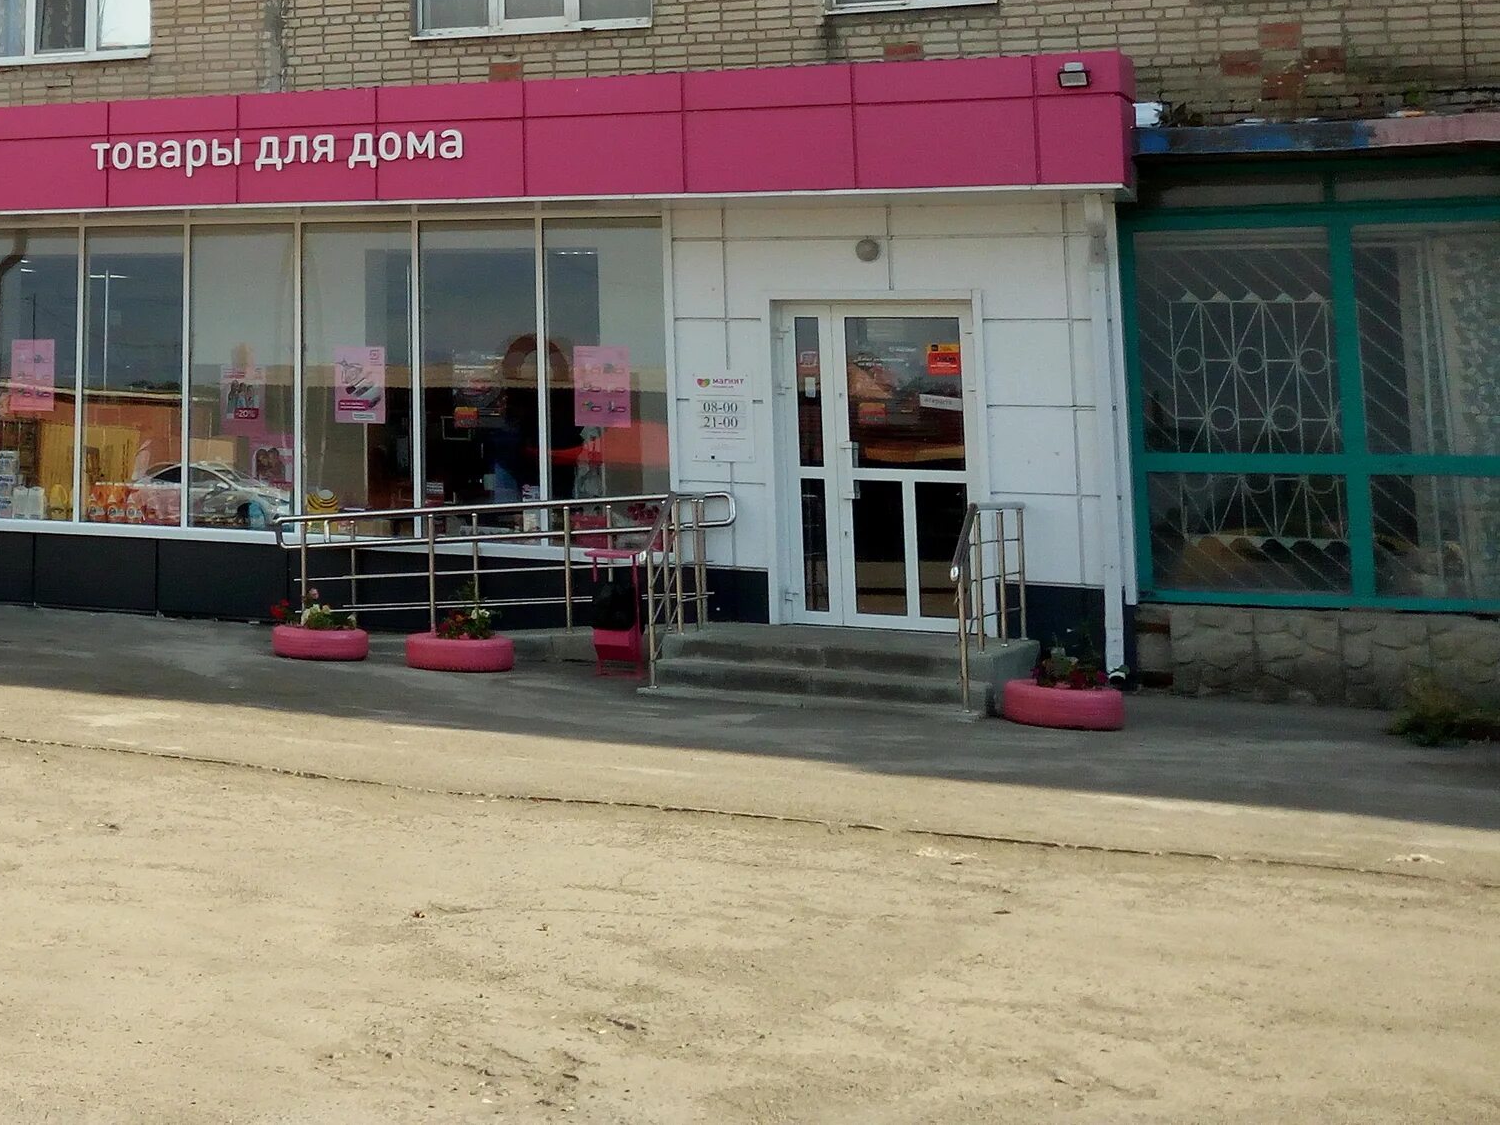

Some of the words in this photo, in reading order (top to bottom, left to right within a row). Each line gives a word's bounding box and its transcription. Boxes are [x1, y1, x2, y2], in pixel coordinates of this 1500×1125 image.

[90, 137, 241, 178] товары
[254, 133, 335, 172] для
[347, 127, 464, 170] дома
[703, 401, 738, 413] 08-00
[703, 416, 738, 428] 21-00
